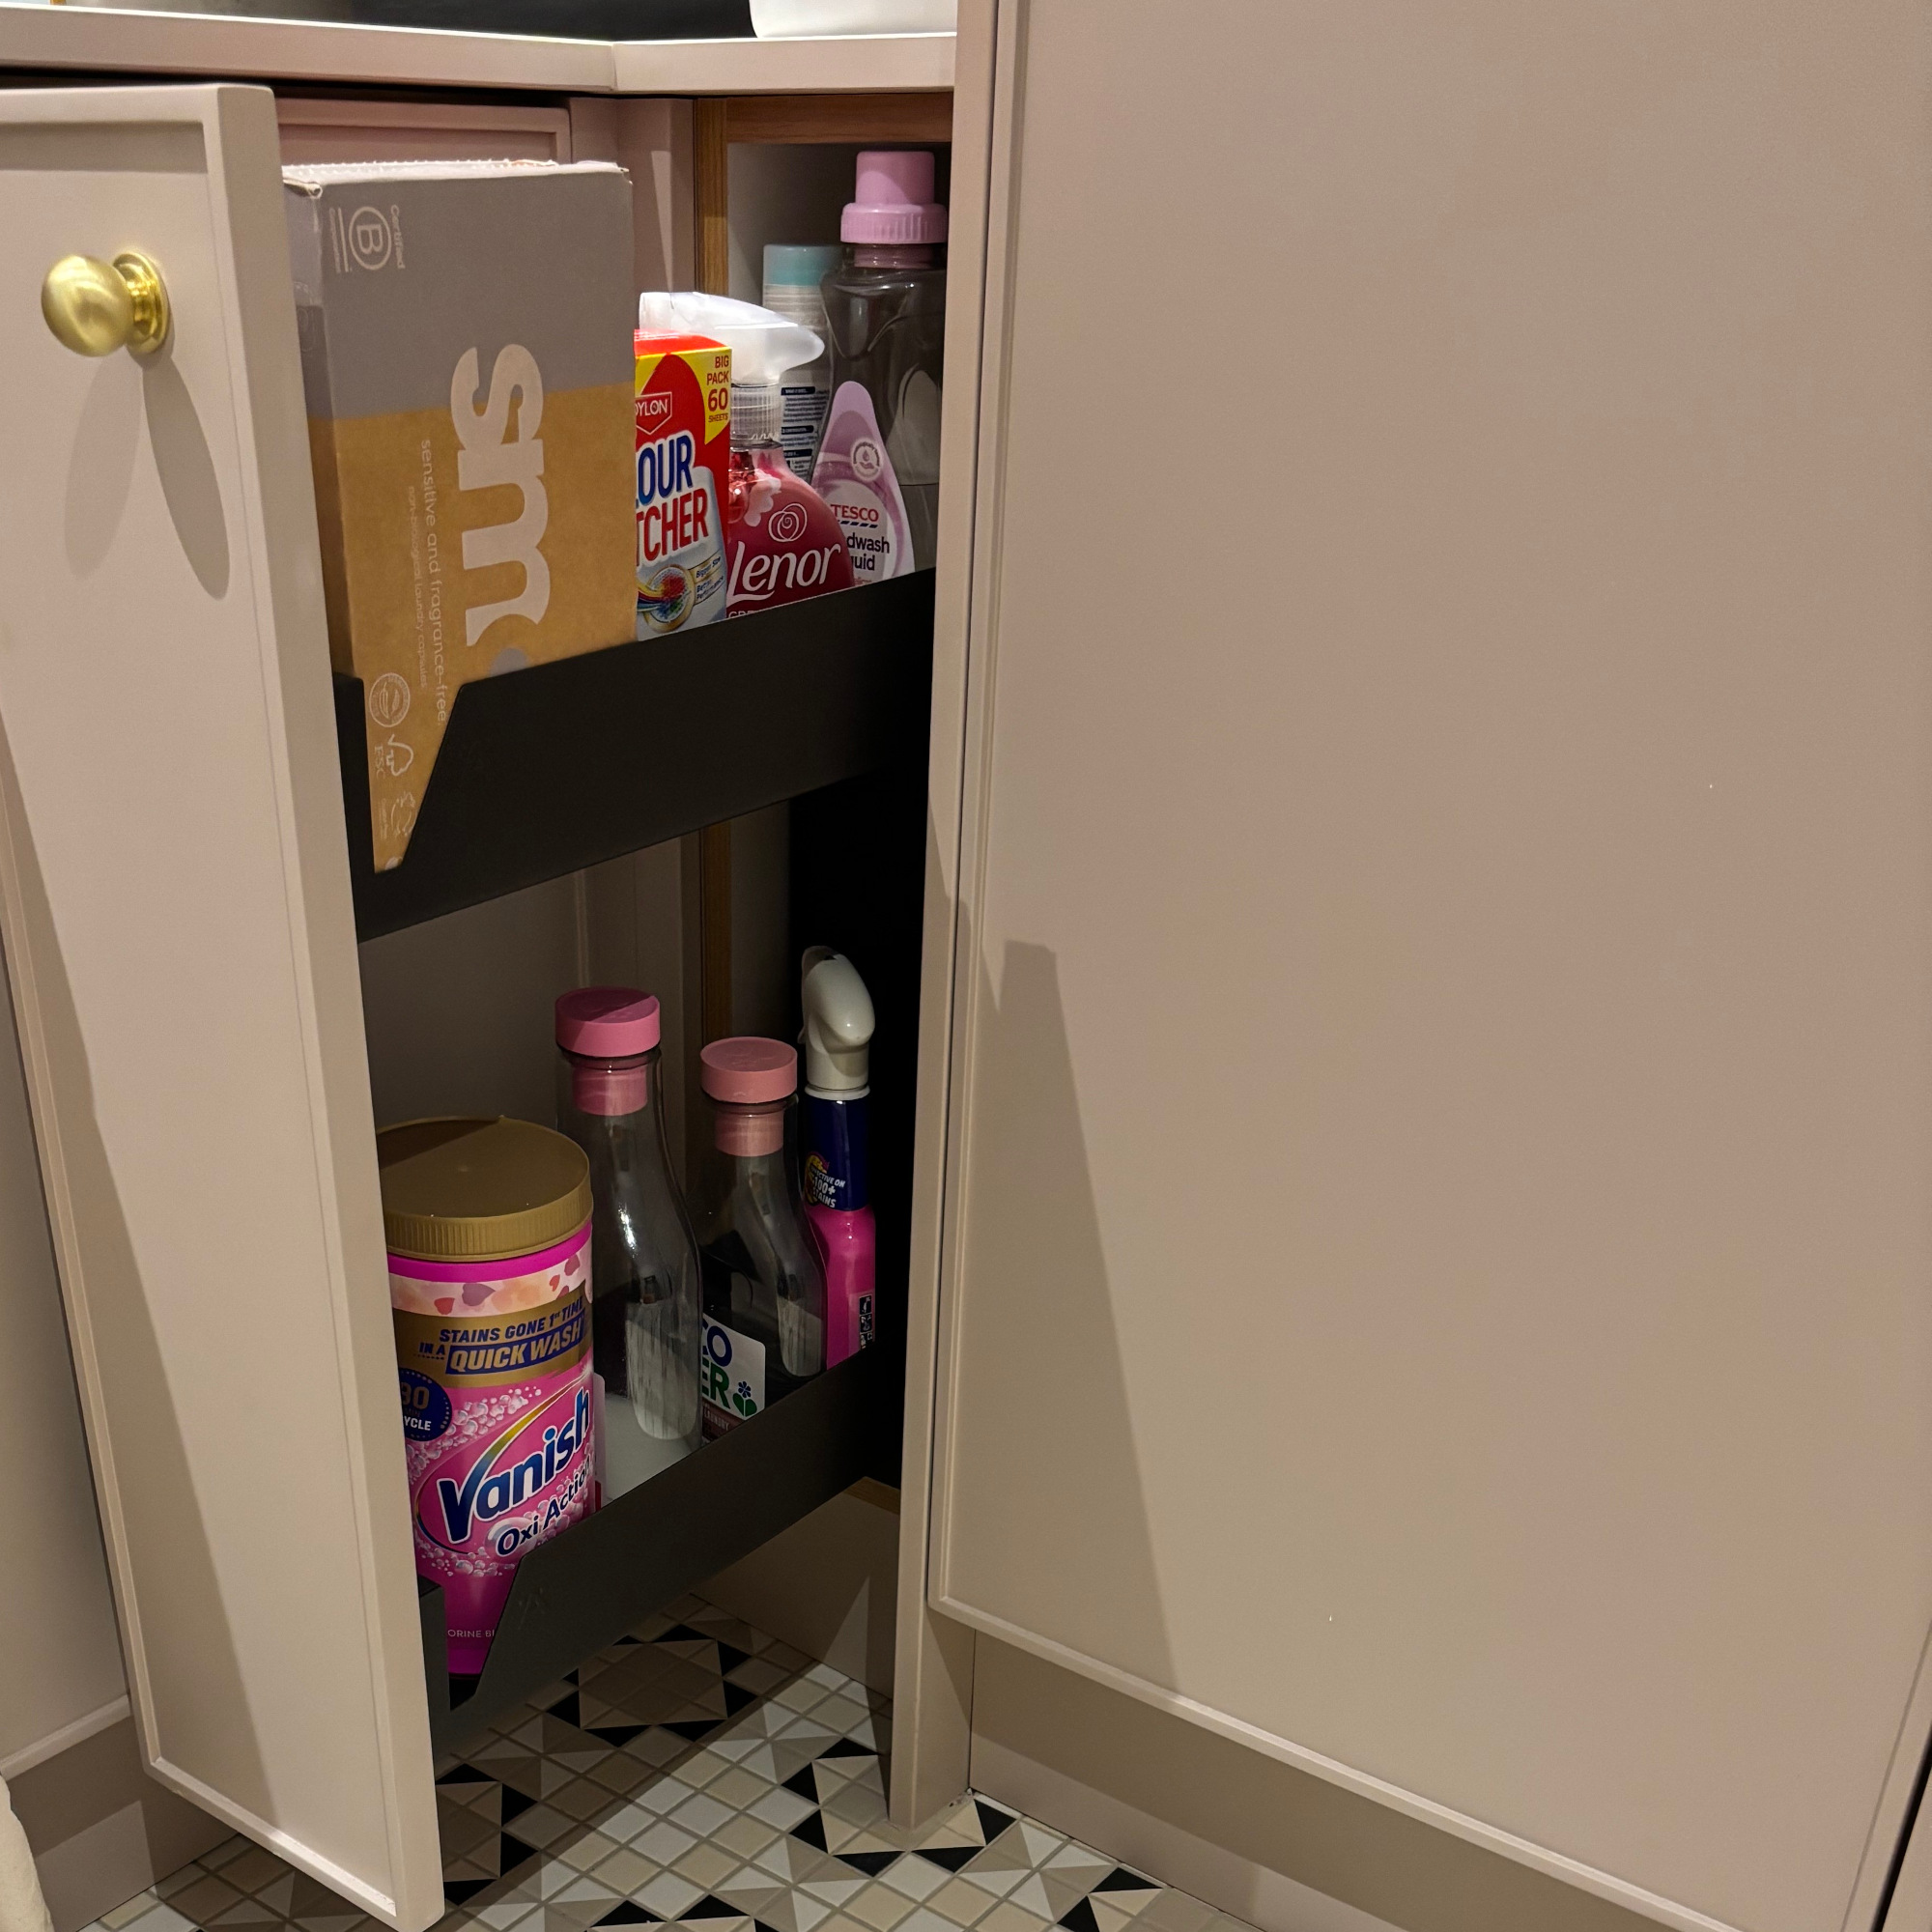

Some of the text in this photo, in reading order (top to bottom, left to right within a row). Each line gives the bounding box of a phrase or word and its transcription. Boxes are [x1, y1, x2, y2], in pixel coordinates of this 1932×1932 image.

[355, 223, 384, 255] B
[714, 355, 730, 368] BIG
[706, 371, 730, 386] PACK
[708, 387, 728, 412] 60
[708, 412, 729, 423] SHEETS
[420, 439, 439, 526] sensitive
[636, 435, 694, 508] OUR
[831, 503, 879, 523] TESCO
[427, 533, 441, 573] and
[846, 531, 891, 554] dwash
[726, 541, 841, 604] Lenor
[814, 1177, 837, 1196] 100+
[834, 1179, 846, 1189] ON
[440, 1328, 499, 1343] STAINS
[504, 1318, 546, 1338] GONE
[419, 1318, 582, 1373] IN A QUICK WASH
[404, 1415, 432, 1431] YCLE
[437, 1386, 591, 1544] Vanish
[496, 1455, 591, 1556] Oxi Action
[447, 1629, 482, 1638] ORINE
